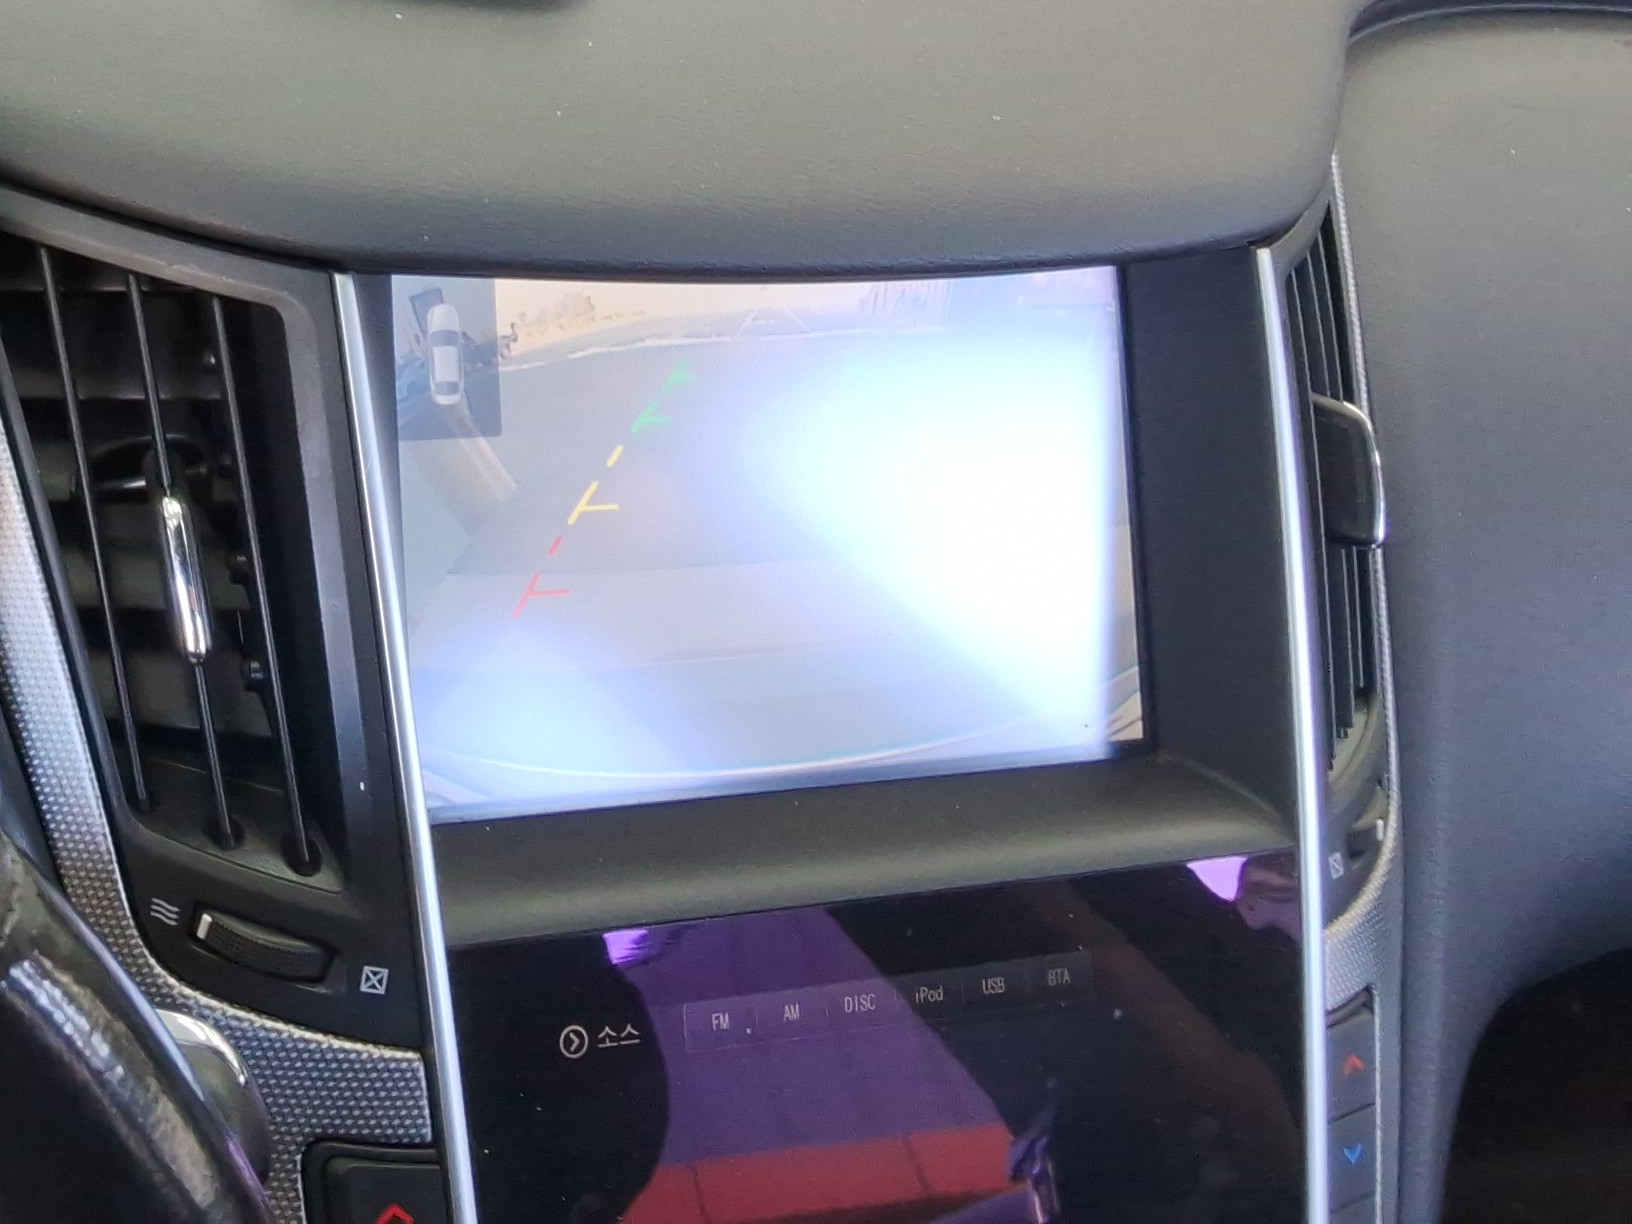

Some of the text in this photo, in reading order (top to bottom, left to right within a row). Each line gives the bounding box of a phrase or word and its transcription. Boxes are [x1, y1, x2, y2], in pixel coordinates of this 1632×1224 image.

[711, 1012, 730, 1031] FM
[783, 1002, 801, 1022] AM
[844, 993, 877, 1014] DISC
[915, 984, 944, 1004] iPod
[982, 977, 1006, 995] USB
[597, 1023, 641, 1048] 소스
